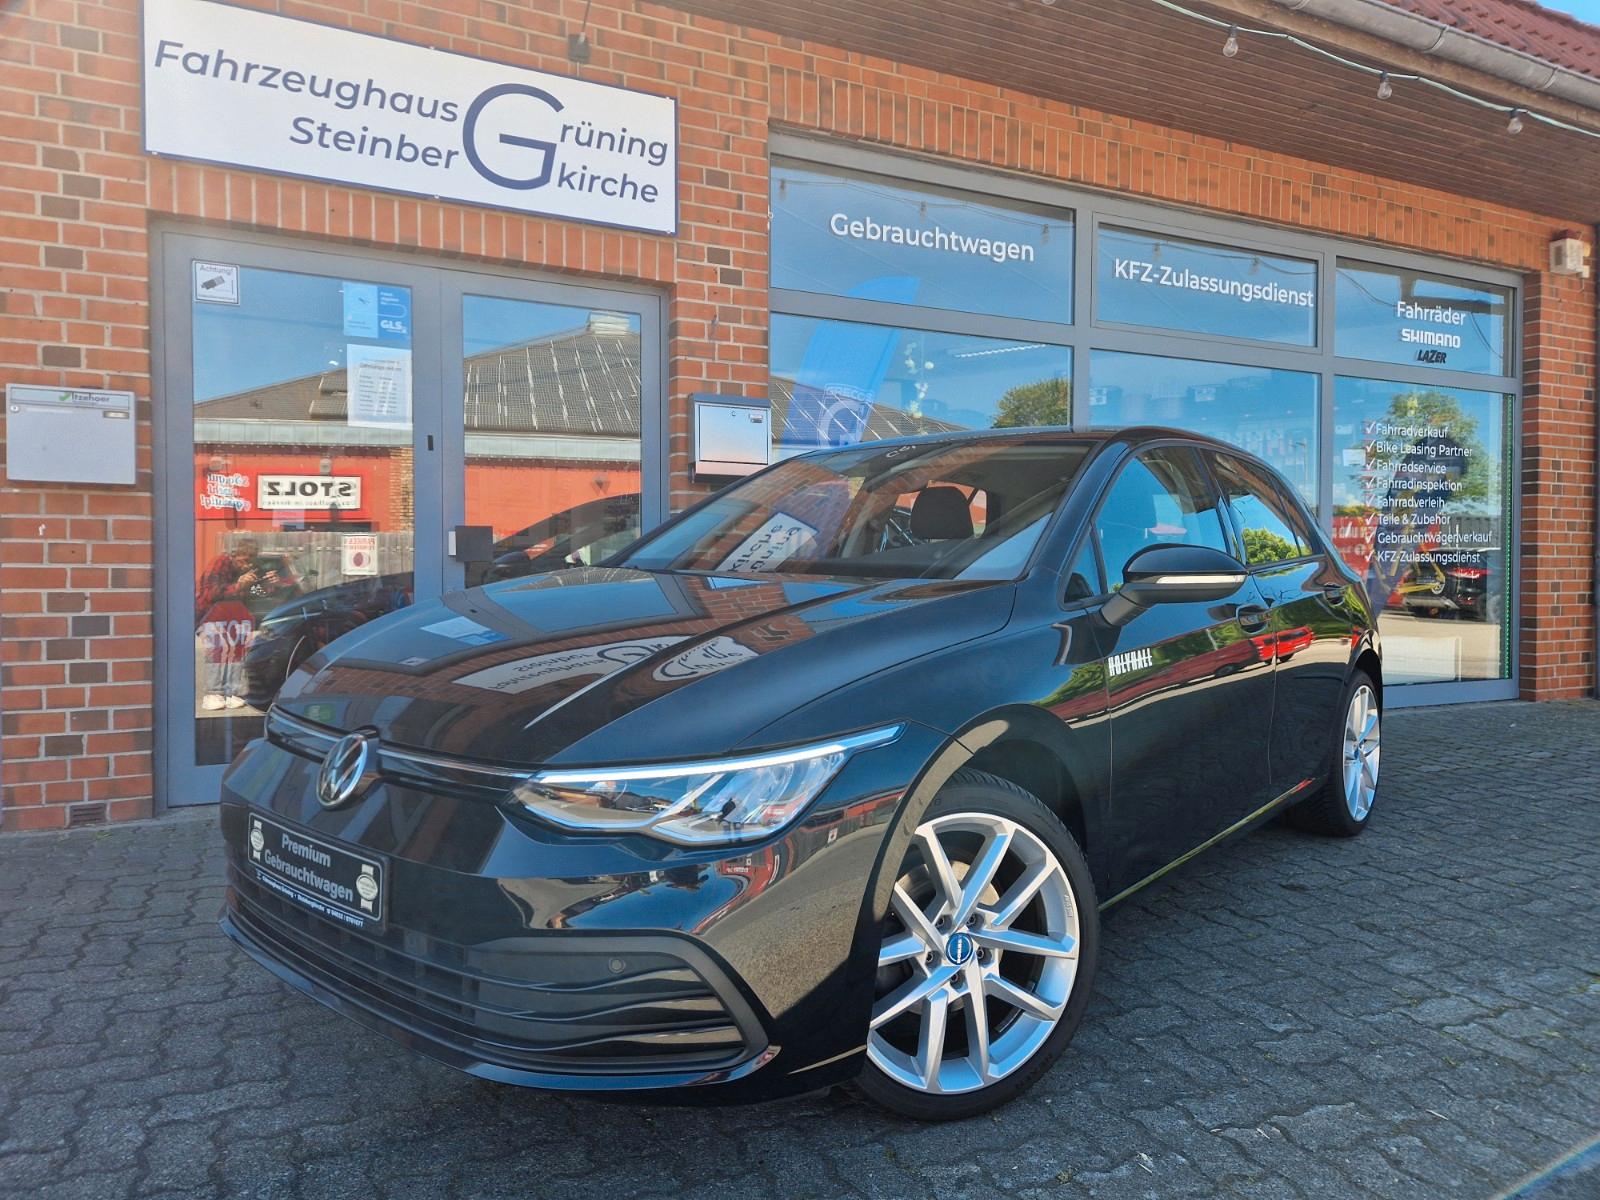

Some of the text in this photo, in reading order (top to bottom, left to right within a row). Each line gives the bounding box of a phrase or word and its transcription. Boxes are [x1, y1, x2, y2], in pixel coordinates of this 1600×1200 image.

[154, 39, 458, 122] Fahrzeughaus
[830, 212, 1035, 263] Gebrauchtwagen
[1115, 258, 1314, 308] KFZ-Zulassungsdienst
[1397, 301, 1466, 326] Fahrräder
[1401, 328, 1461, 349] SHIMANO
[1416, 349, 1447, 364] LAZER
[1376, 423, 1448, 438] Fahrradverkauf
[1376, 441, 1473, 458] Bike Leasing Partner
[1376, 459, 1447, 474] Fahrradservice
[1376, 477, 1463, 492] Fahrradinspektion
[1376, 495, 1445, 508] Fahrradverleih
[1378, 513, 1451, 526] Teile & Zubehör
[1377, 531, 1493, 546] Gebrauchtwagenverkauf
[1377, 551, 1481, 566] KFZ-Zulassungsdienst
[281, 833, 332, 868] Premium
[264, 849, 354, 902] Gebrauchtwagen
